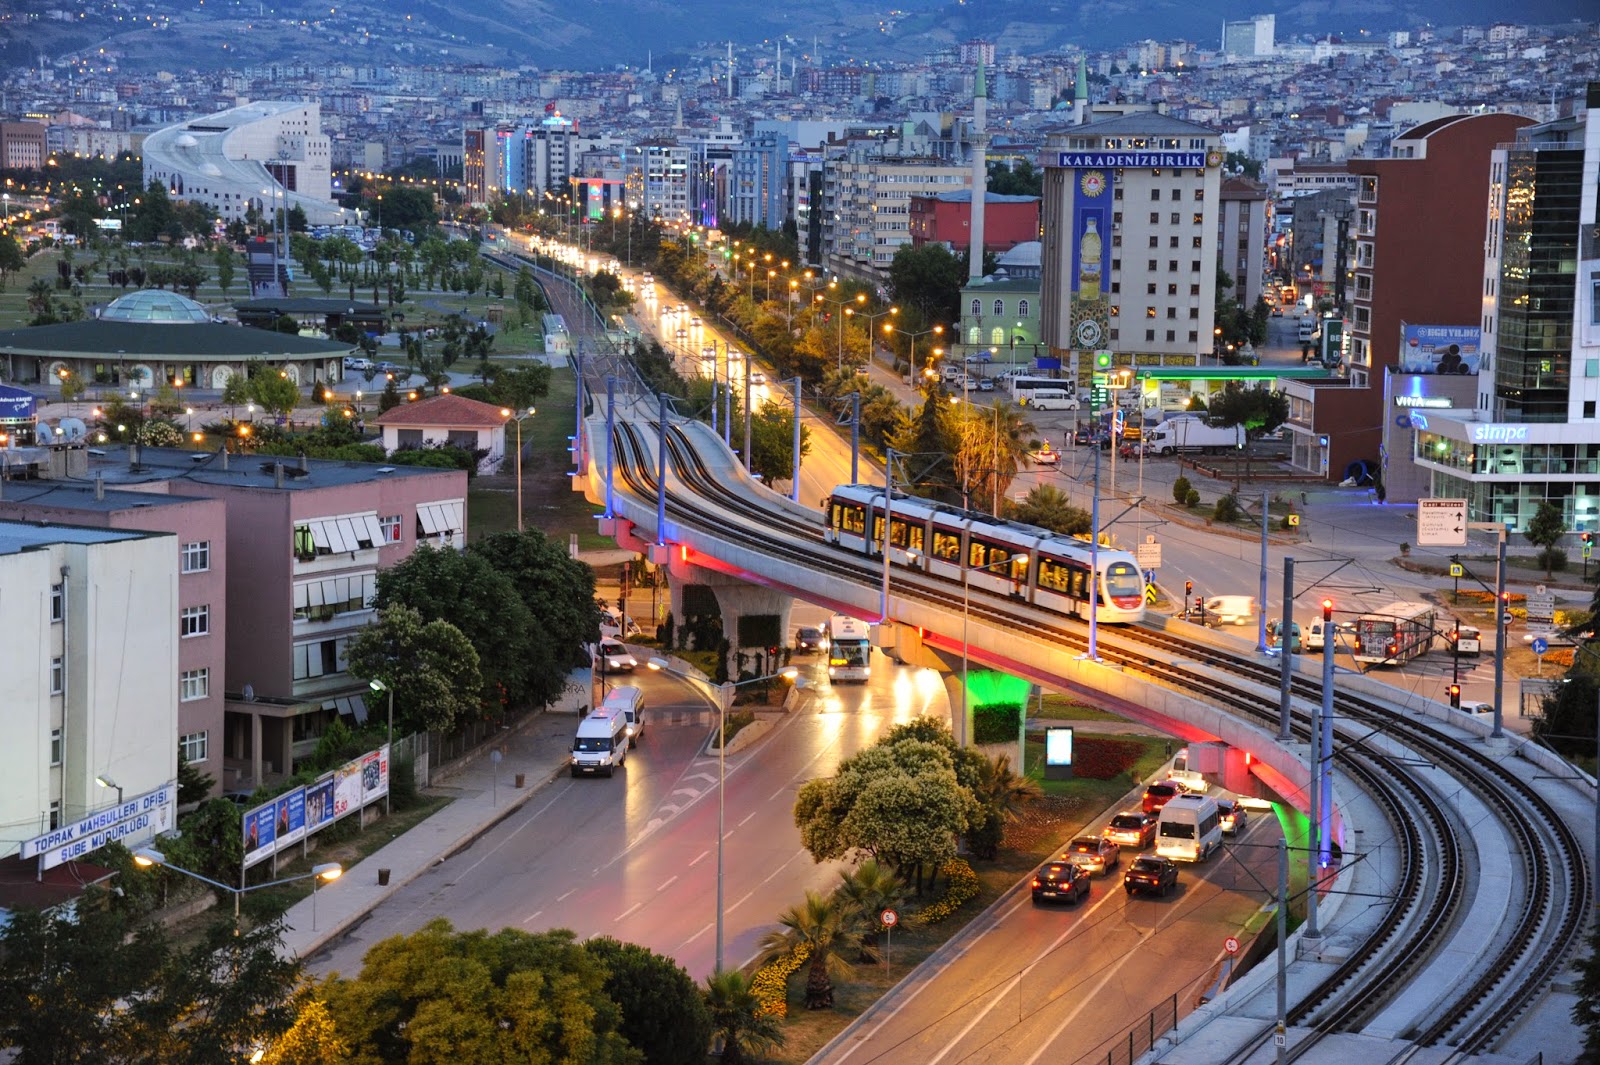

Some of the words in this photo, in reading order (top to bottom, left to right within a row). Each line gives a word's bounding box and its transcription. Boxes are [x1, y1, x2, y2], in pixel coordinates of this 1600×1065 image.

[1063, 152, 1202, 167] KARADENİZBİRLİK
[1427, 328, 1448, 338] EGE
[1448, 328, 1480, 338] YILDIZ
[1474, 423, 1528, 444] simpa
[34, 826, 74, 853] TOPRAK
[79, 802, 139, 834] MAHSULLERİ
[143, 790, 167, 810] OFİSİ
[1276, 1036, 1284, 1045] 10
